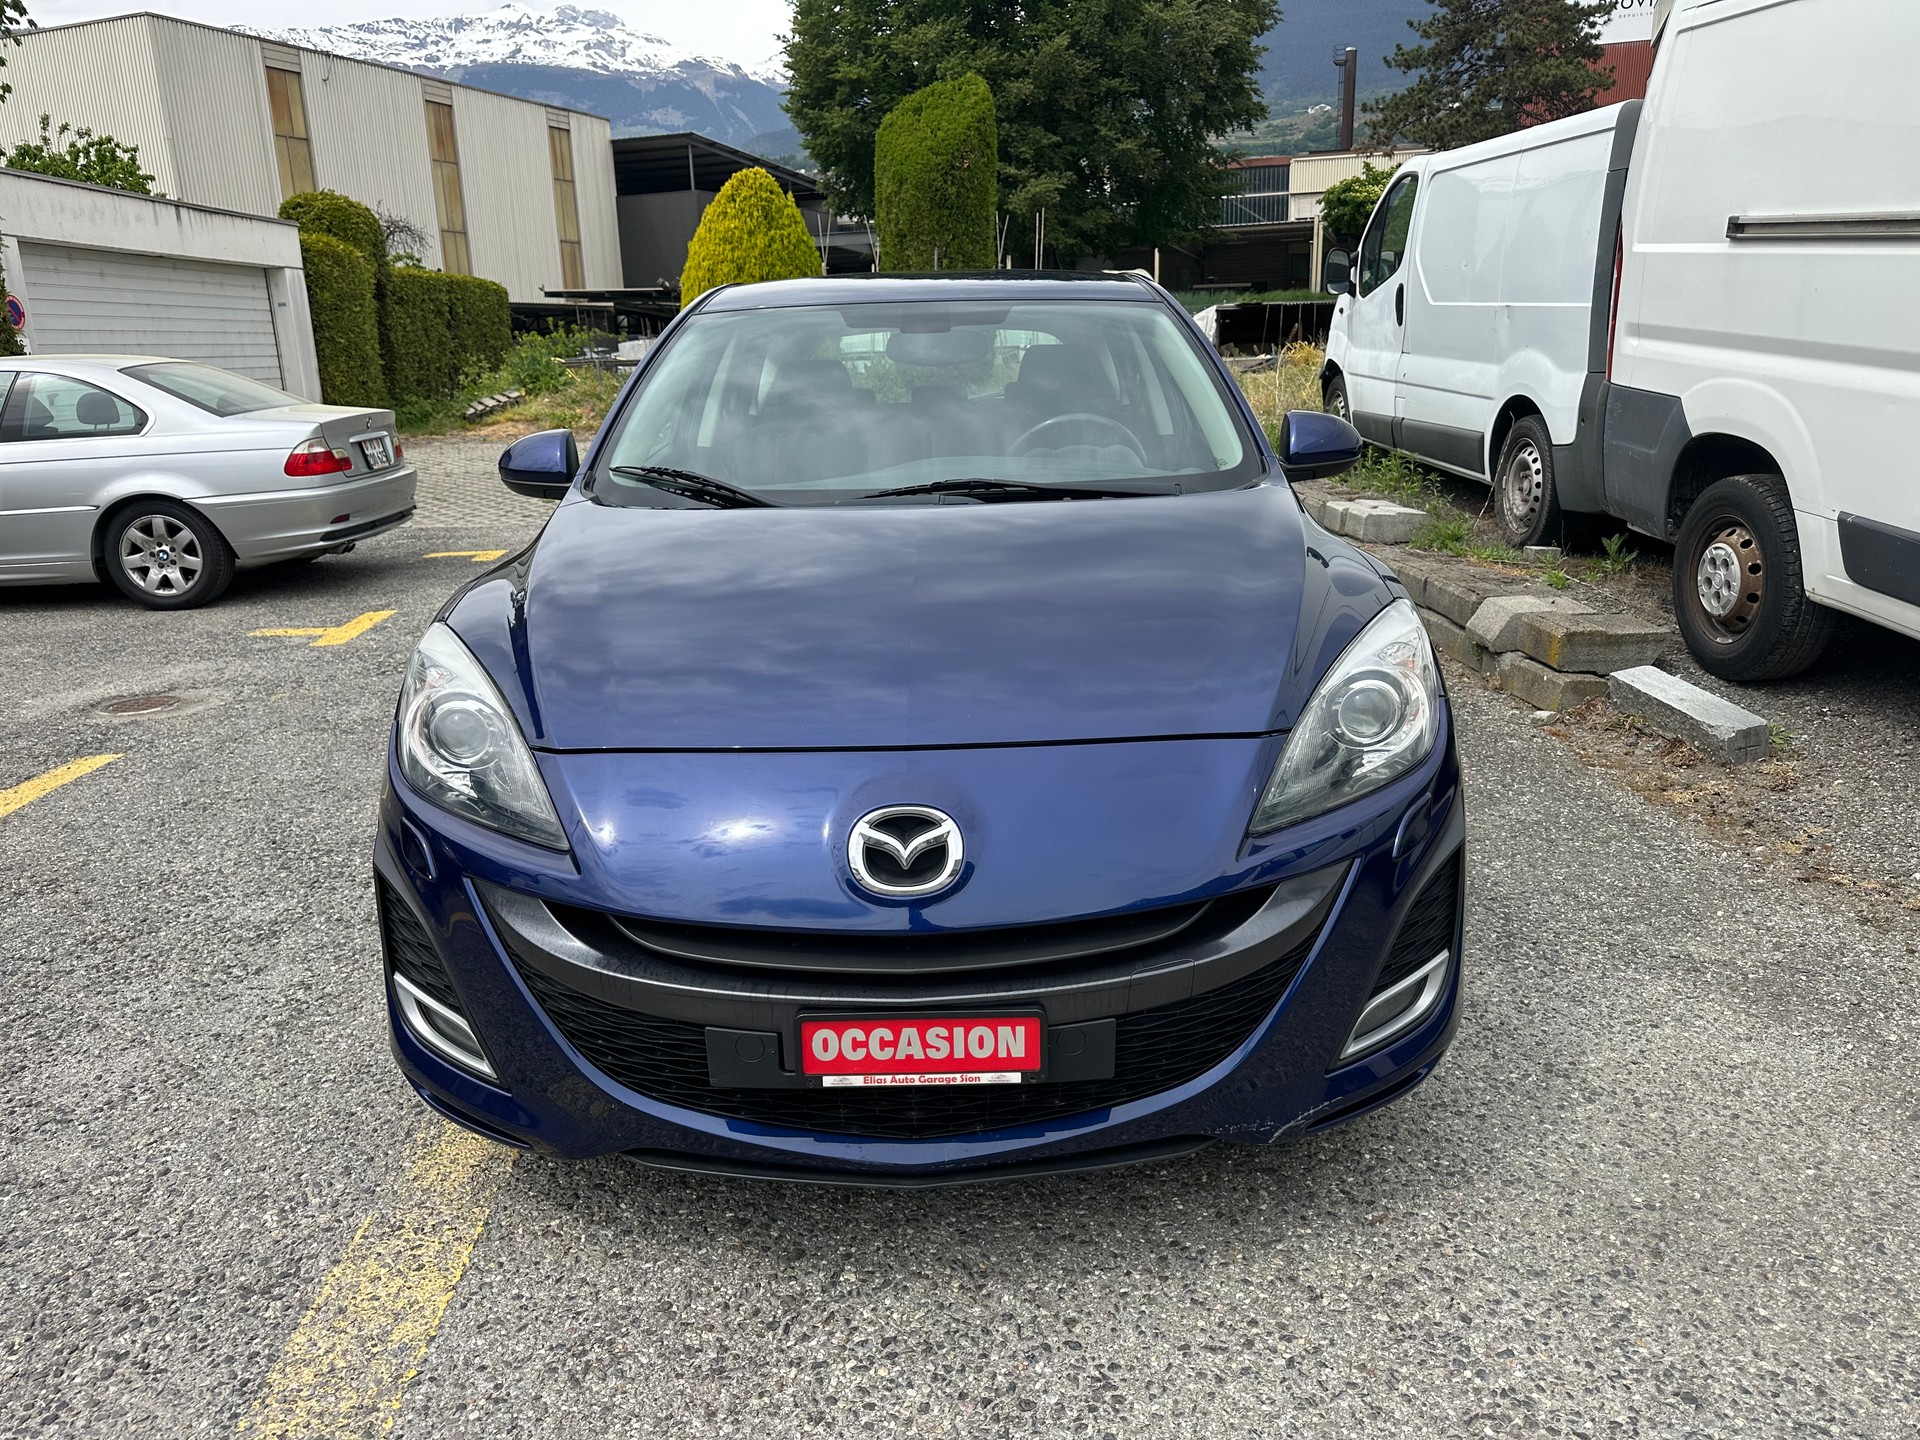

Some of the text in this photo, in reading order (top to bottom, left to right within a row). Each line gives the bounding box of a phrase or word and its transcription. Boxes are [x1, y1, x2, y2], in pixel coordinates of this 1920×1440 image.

[811, 1026, 1025, 1061] OCCASION
[863, 1074, 981, 1085] Elias Auto Garage Sion
